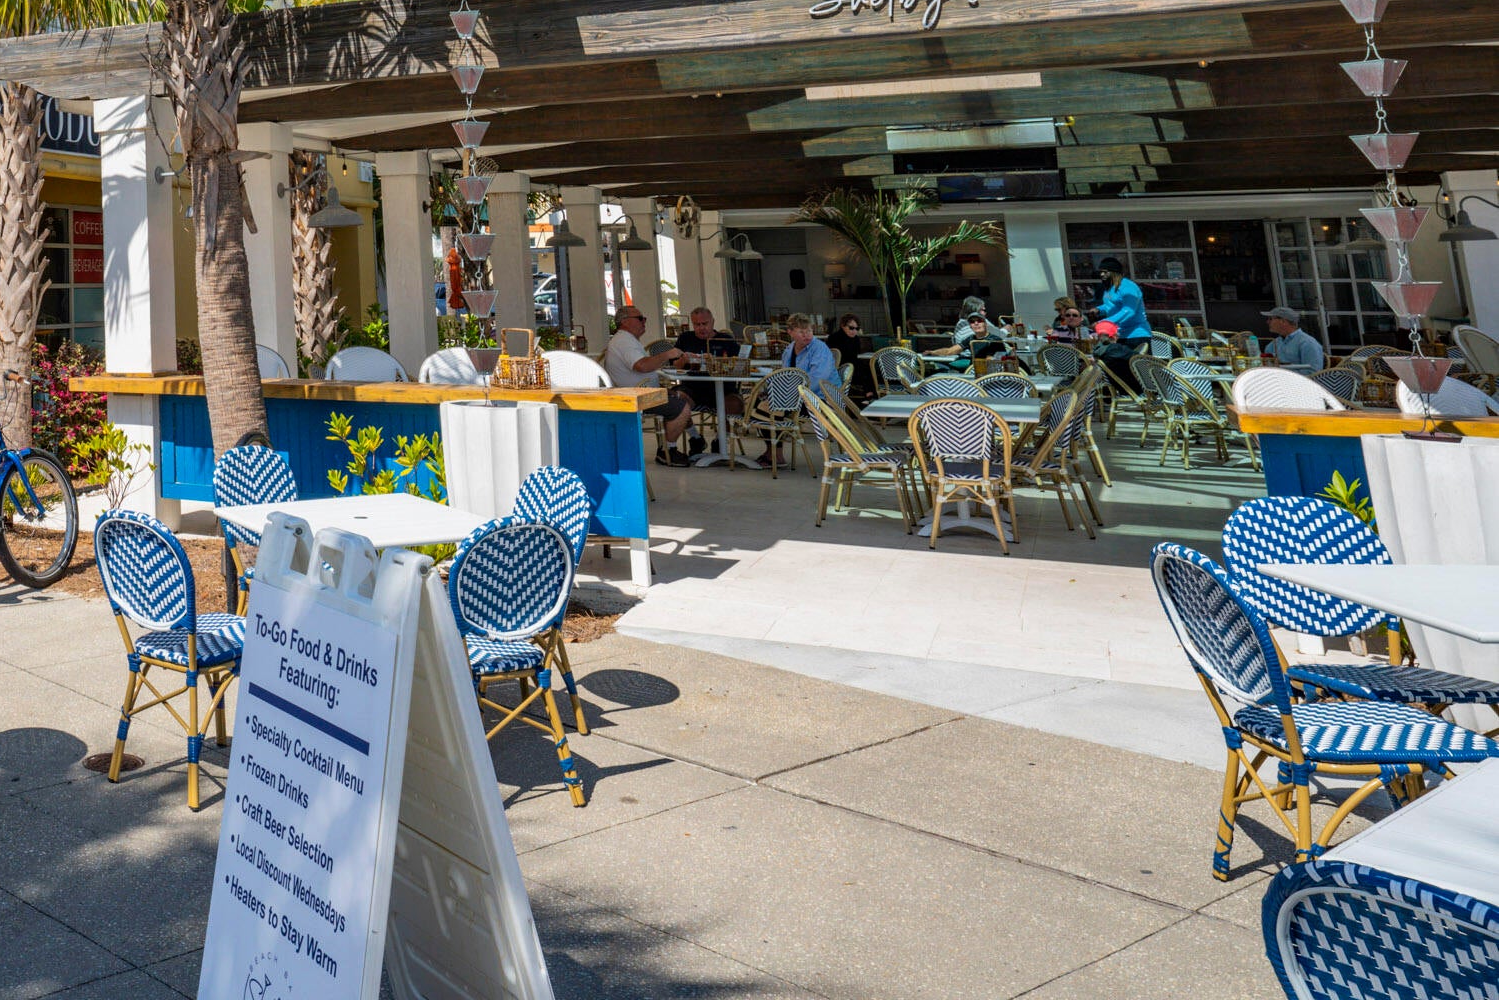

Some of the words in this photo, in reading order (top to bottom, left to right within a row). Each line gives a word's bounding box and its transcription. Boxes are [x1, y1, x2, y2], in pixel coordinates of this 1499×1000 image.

[255, 613, 287, 647] To-Go
[289, 628, 321, 662] Food
[323, 642, 333, 668] &
[336, 647, 378, 688] Drinks
[279, 656, 340, 709] Featuring:
[246, 754, 276, 789] Frozen
[277, 773, 309, 809] Drinks
[251, 715, 292, 757] Specialty
[293, 739, 334, 778] Cocktail
[334, 761, 364, 796] Menu
[241, 794, 263, 825] Craft
[264, 809, 286, 840] Beer
[287, 825, 334, 874] Selection
[235, 834, 257, 865] Local
[256, 850, 292, 892] Discount
[292, 873, 346, 933] Wednesdays
[230, 874, 266, 919] Heaters
[268, 906, 279, 929] to
[280, 914, 304, 953] Stay
[306, 933, 338, 978] Warm
